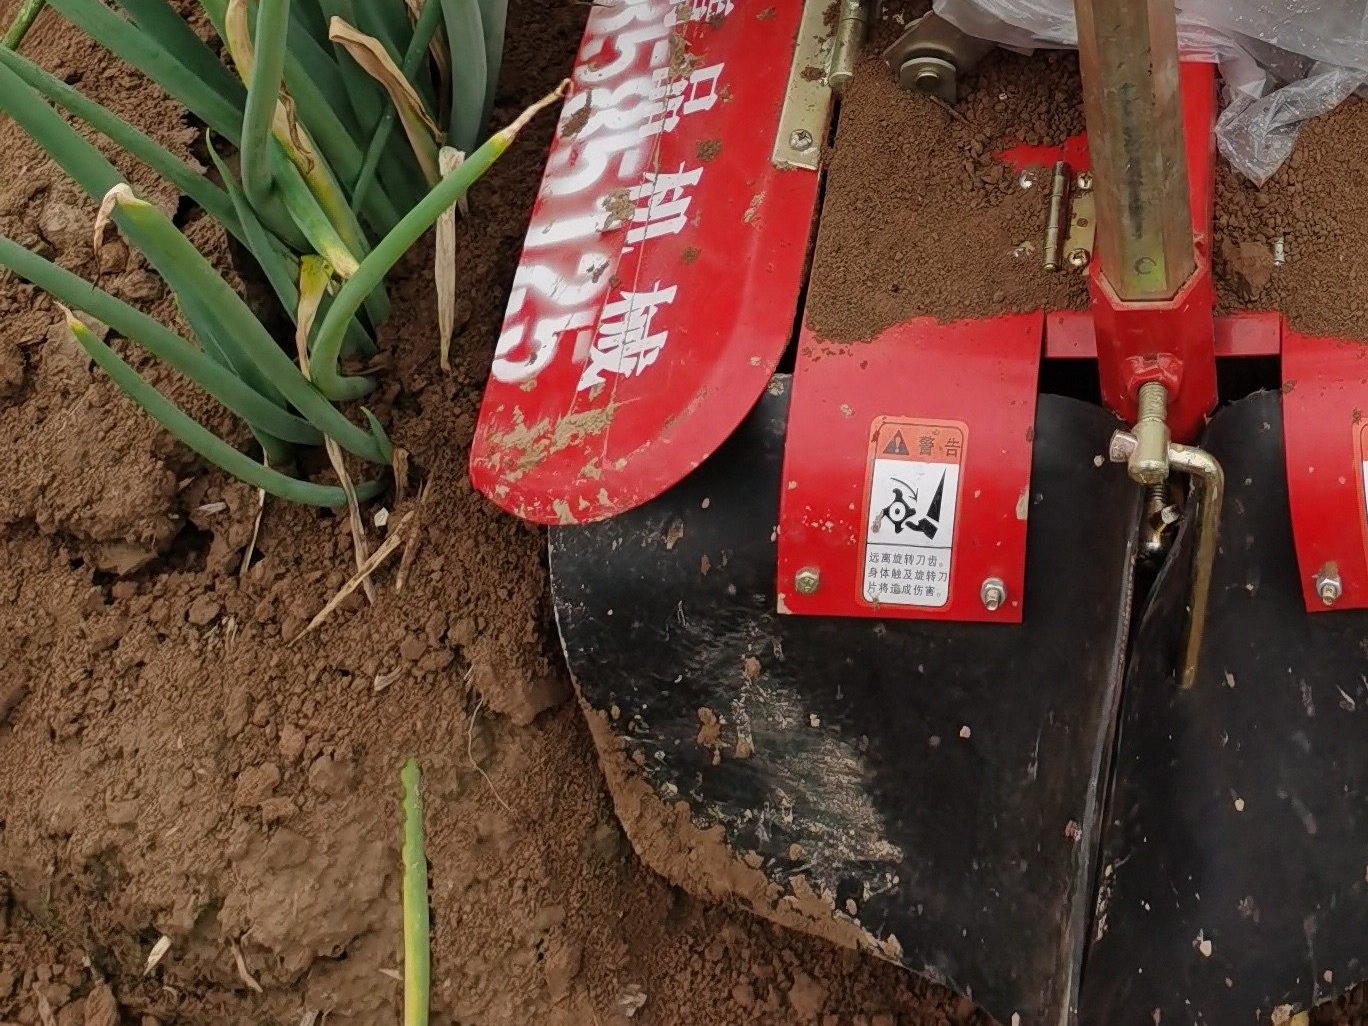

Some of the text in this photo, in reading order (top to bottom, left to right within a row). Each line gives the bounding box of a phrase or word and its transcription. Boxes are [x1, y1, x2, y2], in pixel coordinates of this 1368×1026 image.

[918, 435, 961, 458] 警告
[869, 551, 944, 568] 远离旋转刀齿。
[868, 566, 948, 583] 身体触及旋转刀
[867, 581, 942, 598] 片将造成伤害。
